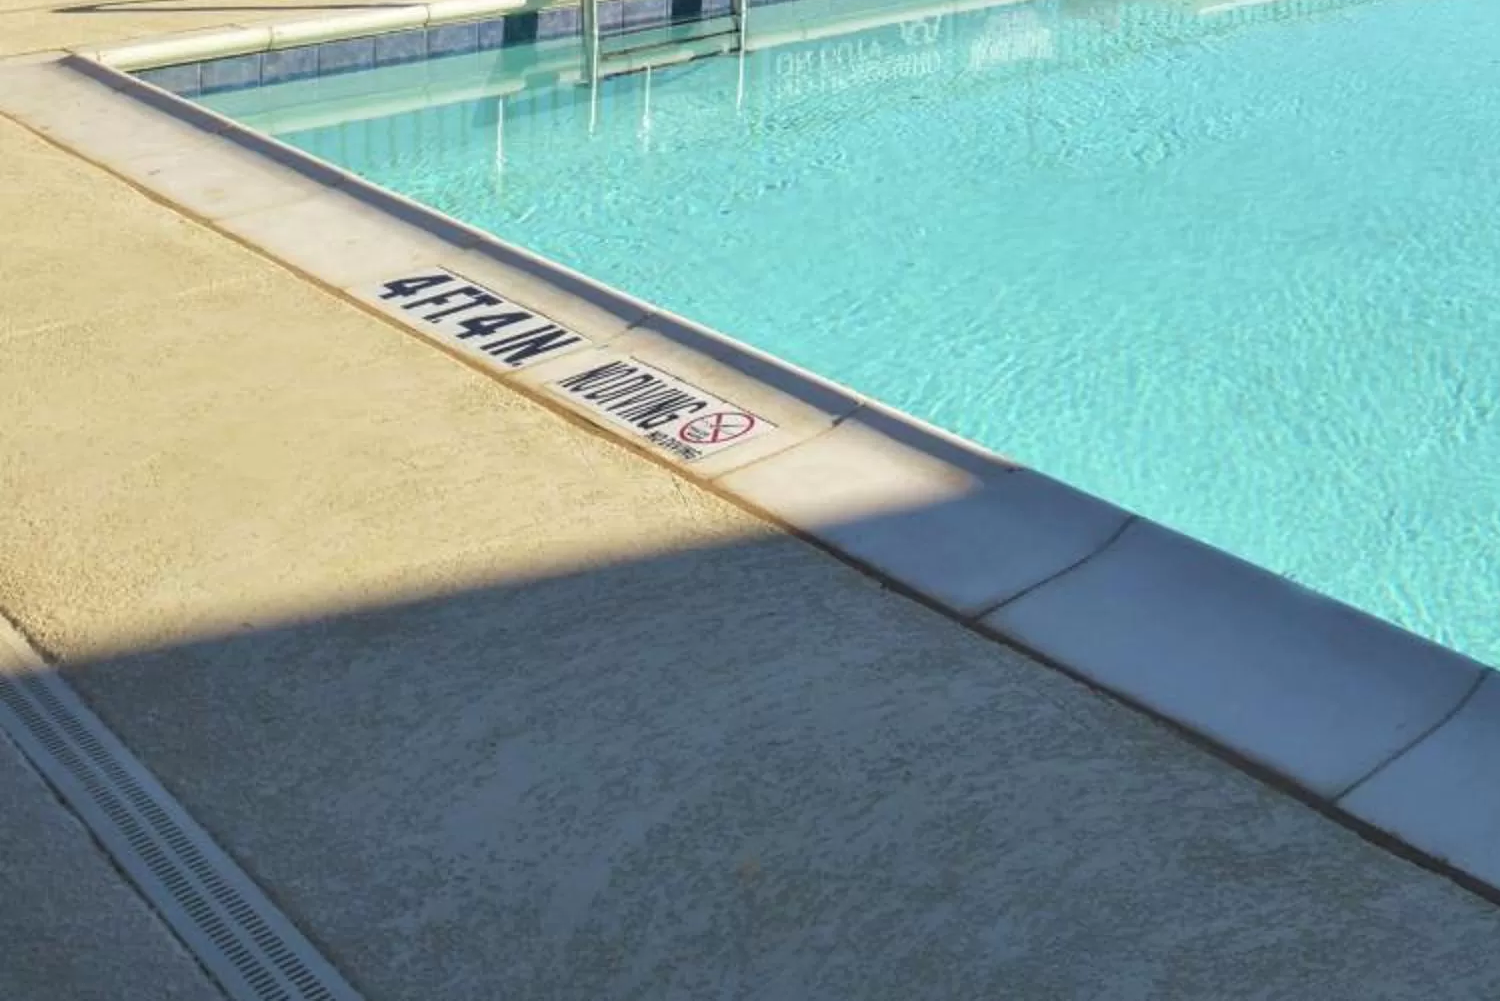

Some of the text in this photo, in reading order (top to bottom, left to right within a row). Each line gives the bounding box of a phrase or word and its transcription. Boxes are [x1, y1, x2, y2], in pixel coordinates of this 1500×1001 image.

[378, 274, 456, 300] 4
[456, 311, 534, 340] 4
[556, 360, 708, 430] NO DIVING
